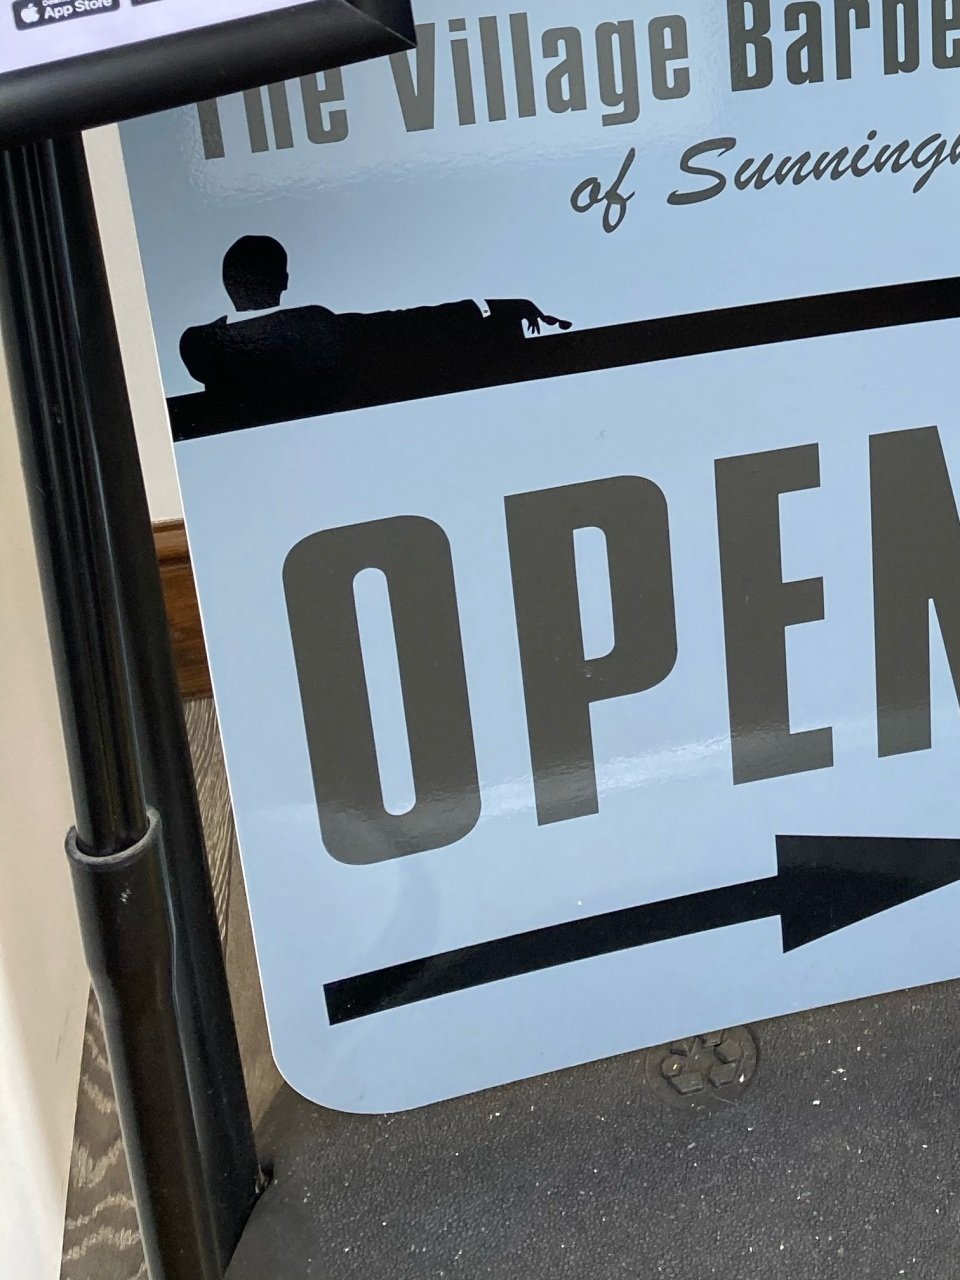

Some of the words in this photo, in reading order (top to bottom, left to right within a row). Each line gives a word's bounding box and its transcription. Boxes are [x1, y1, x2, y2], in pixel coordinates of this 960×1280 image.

[44, 5, 74, 20] App
[389, 11, 691, 133] Village
[570, 148, 637, 233] of
